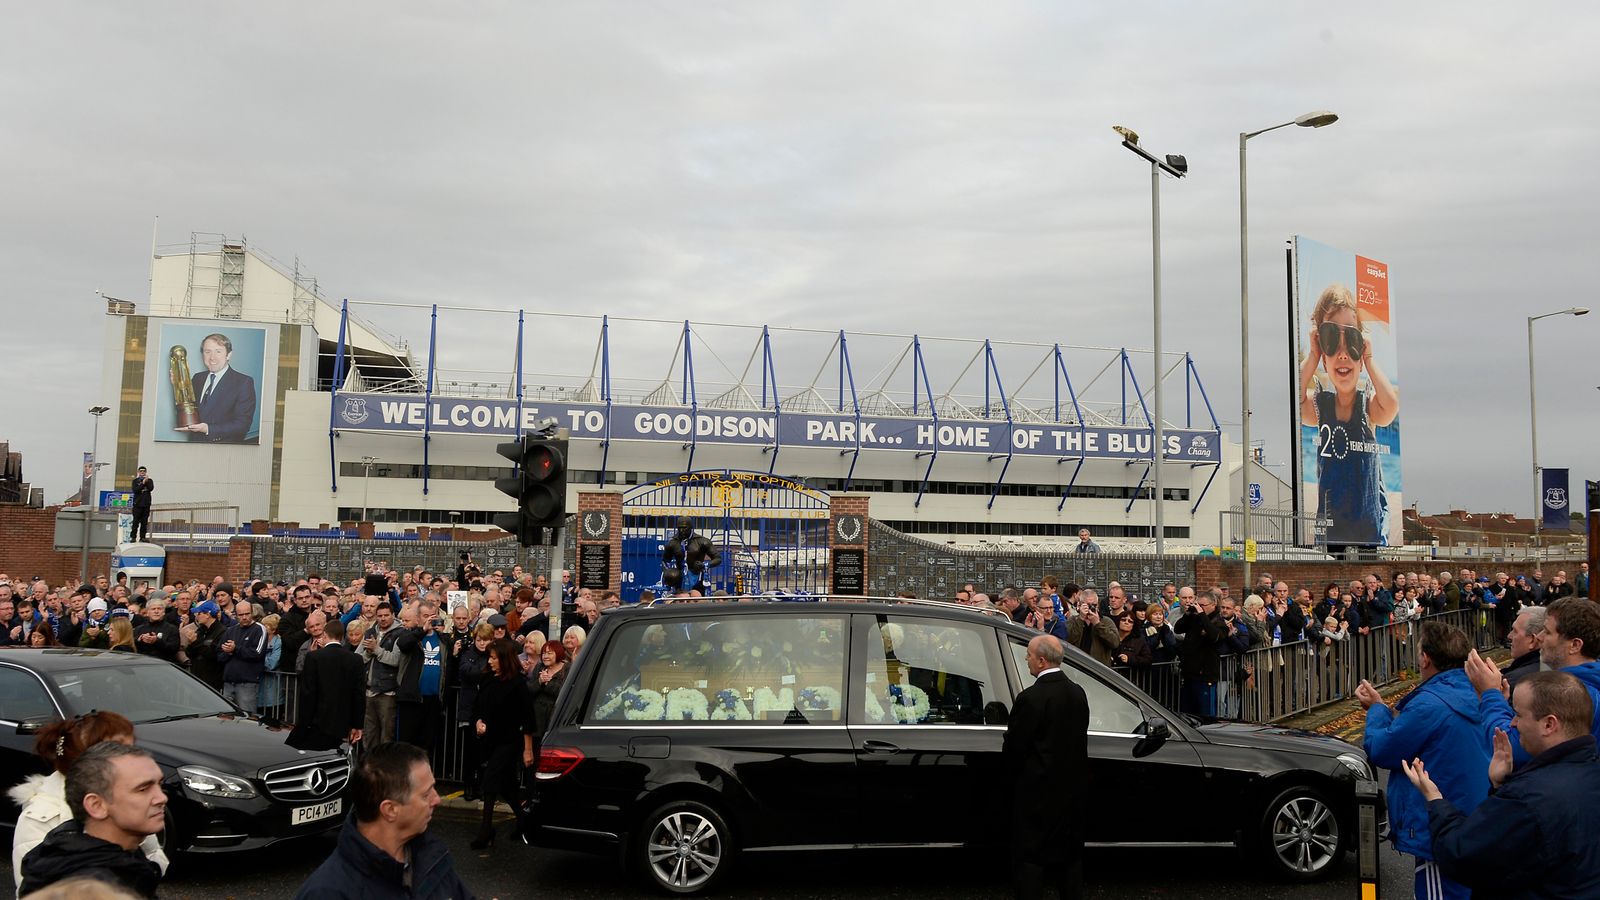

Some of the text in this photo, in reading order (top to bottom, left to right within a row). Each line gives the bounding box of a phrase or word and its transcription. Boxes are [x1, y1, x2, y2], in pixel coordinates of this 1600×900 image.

[380, 401, 539, 429] WELCOME
[567, 409, 604, 432] TO
[634, 412, 775, 438] GOODISON
[806, 420, 902, 444] PARK...
[917, 424, 990, 447] HOME
[1012, 428, 1043, 449] OF
[1051, 430, 1099, 452] THE
[1320, 424, 1349, 460] 20
[1350, 440, 1363, 452] YEARS
[1188, 446, 1210, 458] Chang
[680, 472, 720, 482] SATIS
[631, 508, 700, 516] EVERTON
[299, 801, 338, 821] PC14 XPC
